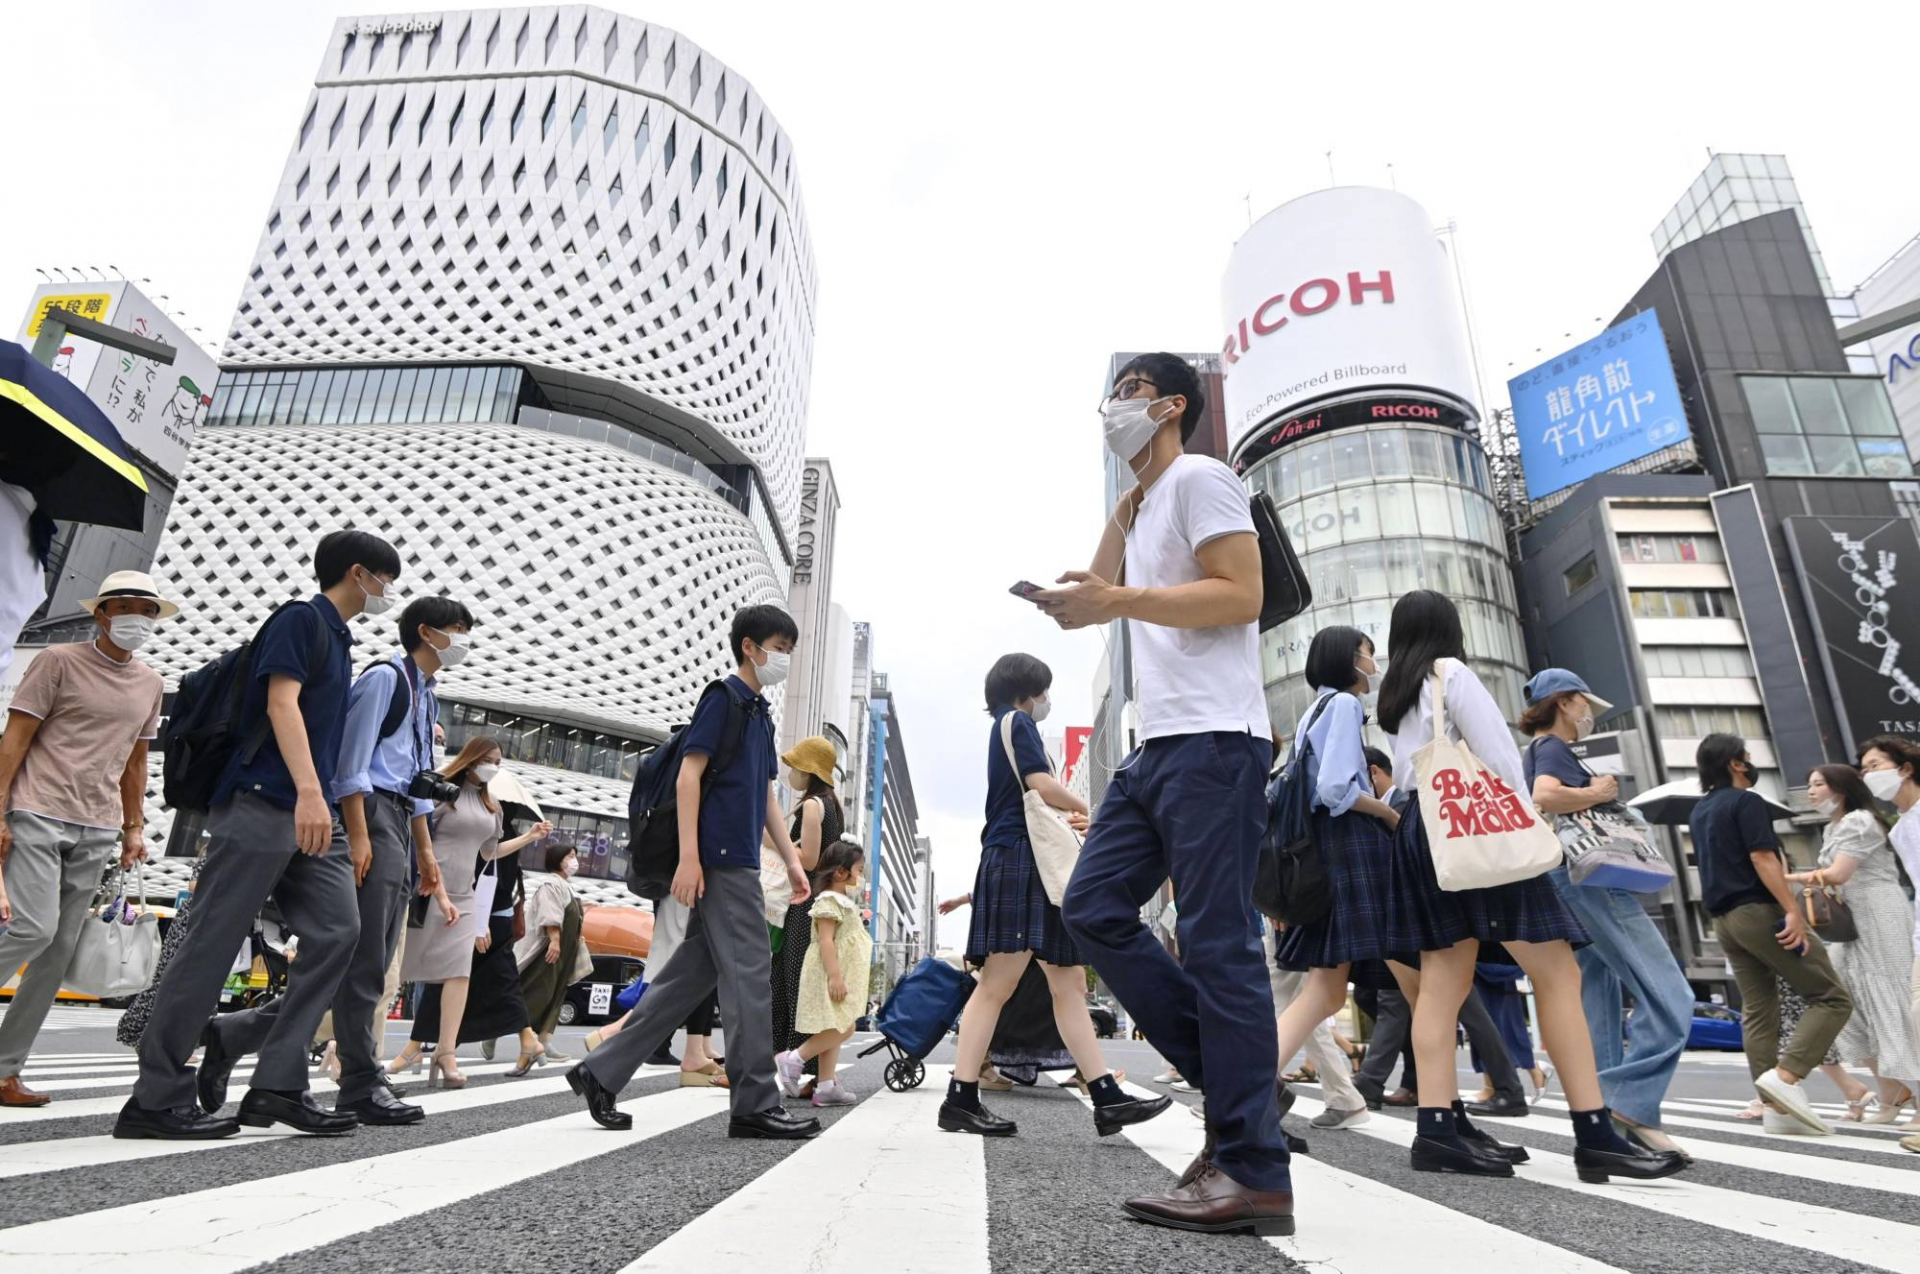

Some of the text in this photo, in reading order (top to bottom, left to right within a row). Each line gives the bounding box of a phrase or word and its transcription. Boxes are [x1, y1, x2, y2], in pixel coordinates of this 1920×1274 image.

[364, 20, 436, 35] SAPPORO
[1222, 269, 1395, 381] RICOH
[1245, 363, 1407, 422] Eco-Powered Billboard
[1371, 404, 1439, 418] RICOH
[1545, 357, 1633, 422] 龍角散
[1542, 390, 1656, 456] ダイレクト
[793, 467, 819, 584] GINZA CORE
[1439, 793, 1535, 839] Mold
